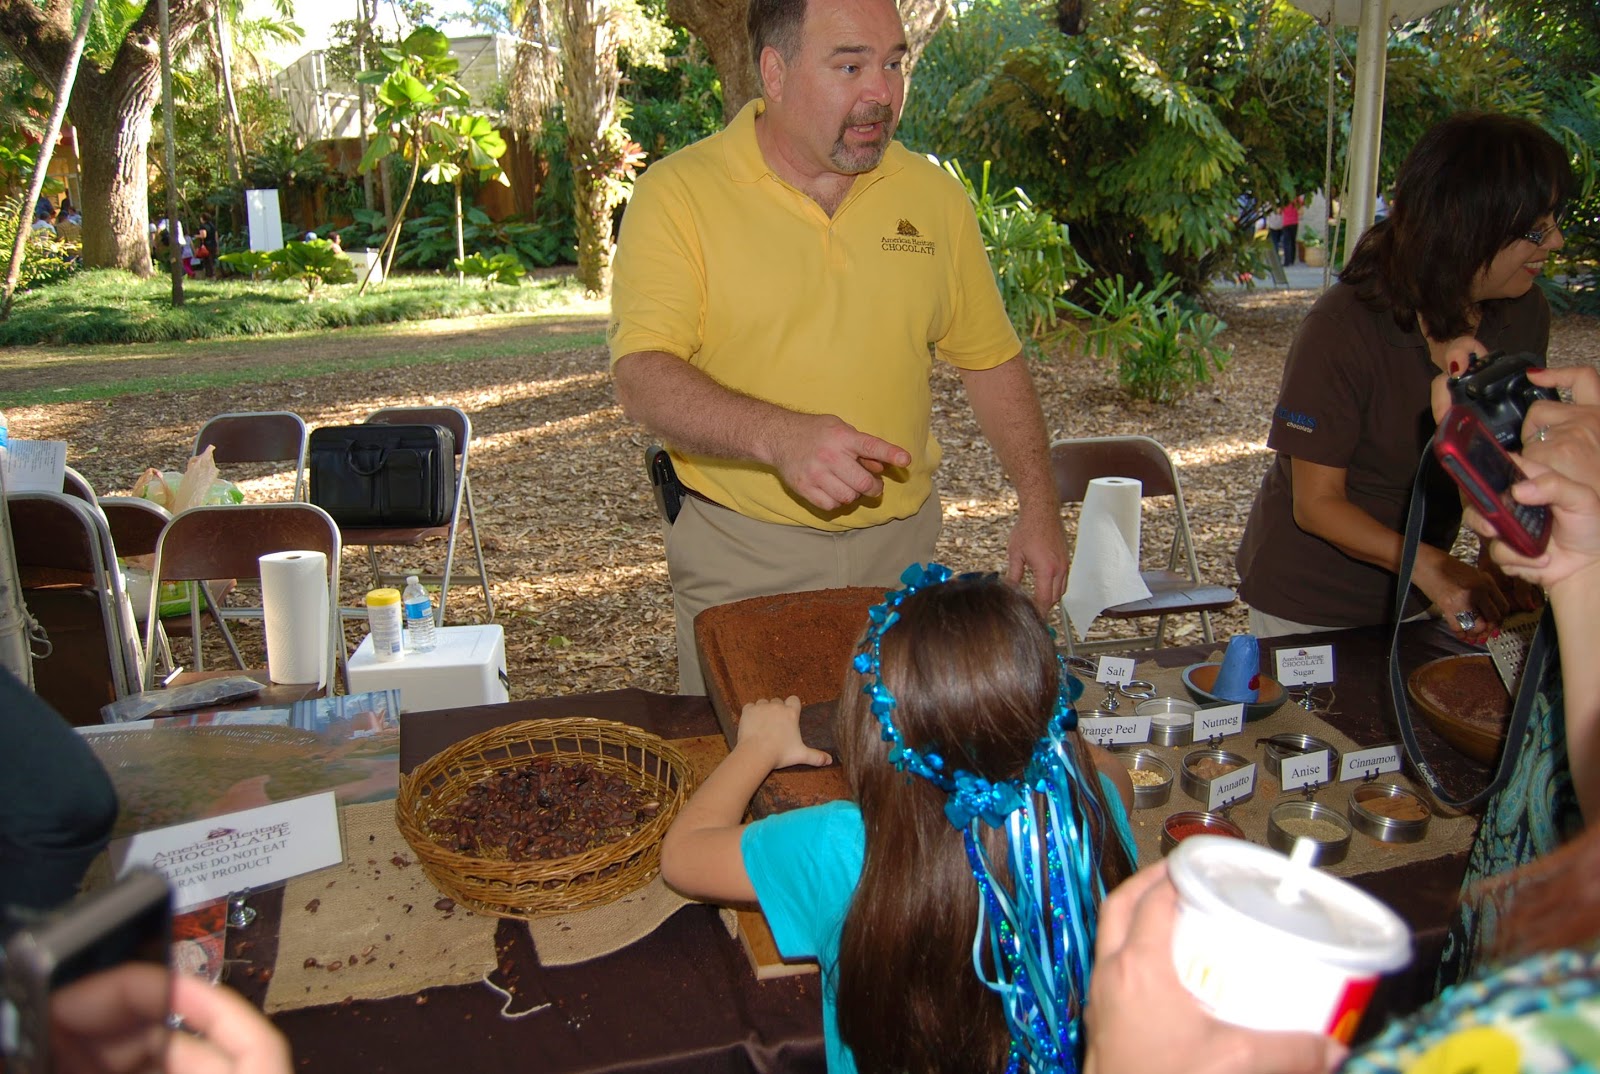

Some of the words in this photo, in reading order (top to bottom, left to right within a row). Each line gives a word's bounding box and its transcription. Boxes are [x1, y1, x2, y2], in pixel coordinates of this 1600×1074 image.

[881, 236, 911, 244] American
[881, 243, 935, 255] CHOCOLATE
[1282, 659, 1325, 668] CHOCOLATE
[1106, 666, 1125, 677] Salt
[1293, 669, 1315, 678] Sugar
[1115, 723, 1137, 734] Peel
[1202, 715, 1239, 730] Nutmeg
[1349, 754, 1397, 770] Cinnamon
[1291, 764, 1321, 779] Anise
[1216, 774, 1250, 796] Annatto
[152, 838, 224, 861] American
[229, 822, 289, 841] Heritage
[153, 827, 290, 868] CHOCOLATE
[164, 862, 208, 880] LEASE
[211, 855, 230, 867] DO
[233, 848, 261, 861] NOT
[263, 840, 287, 853] EAT
[178, 875, 208, 889] RAW
[212, 855, 273, 879] PRODUCT
